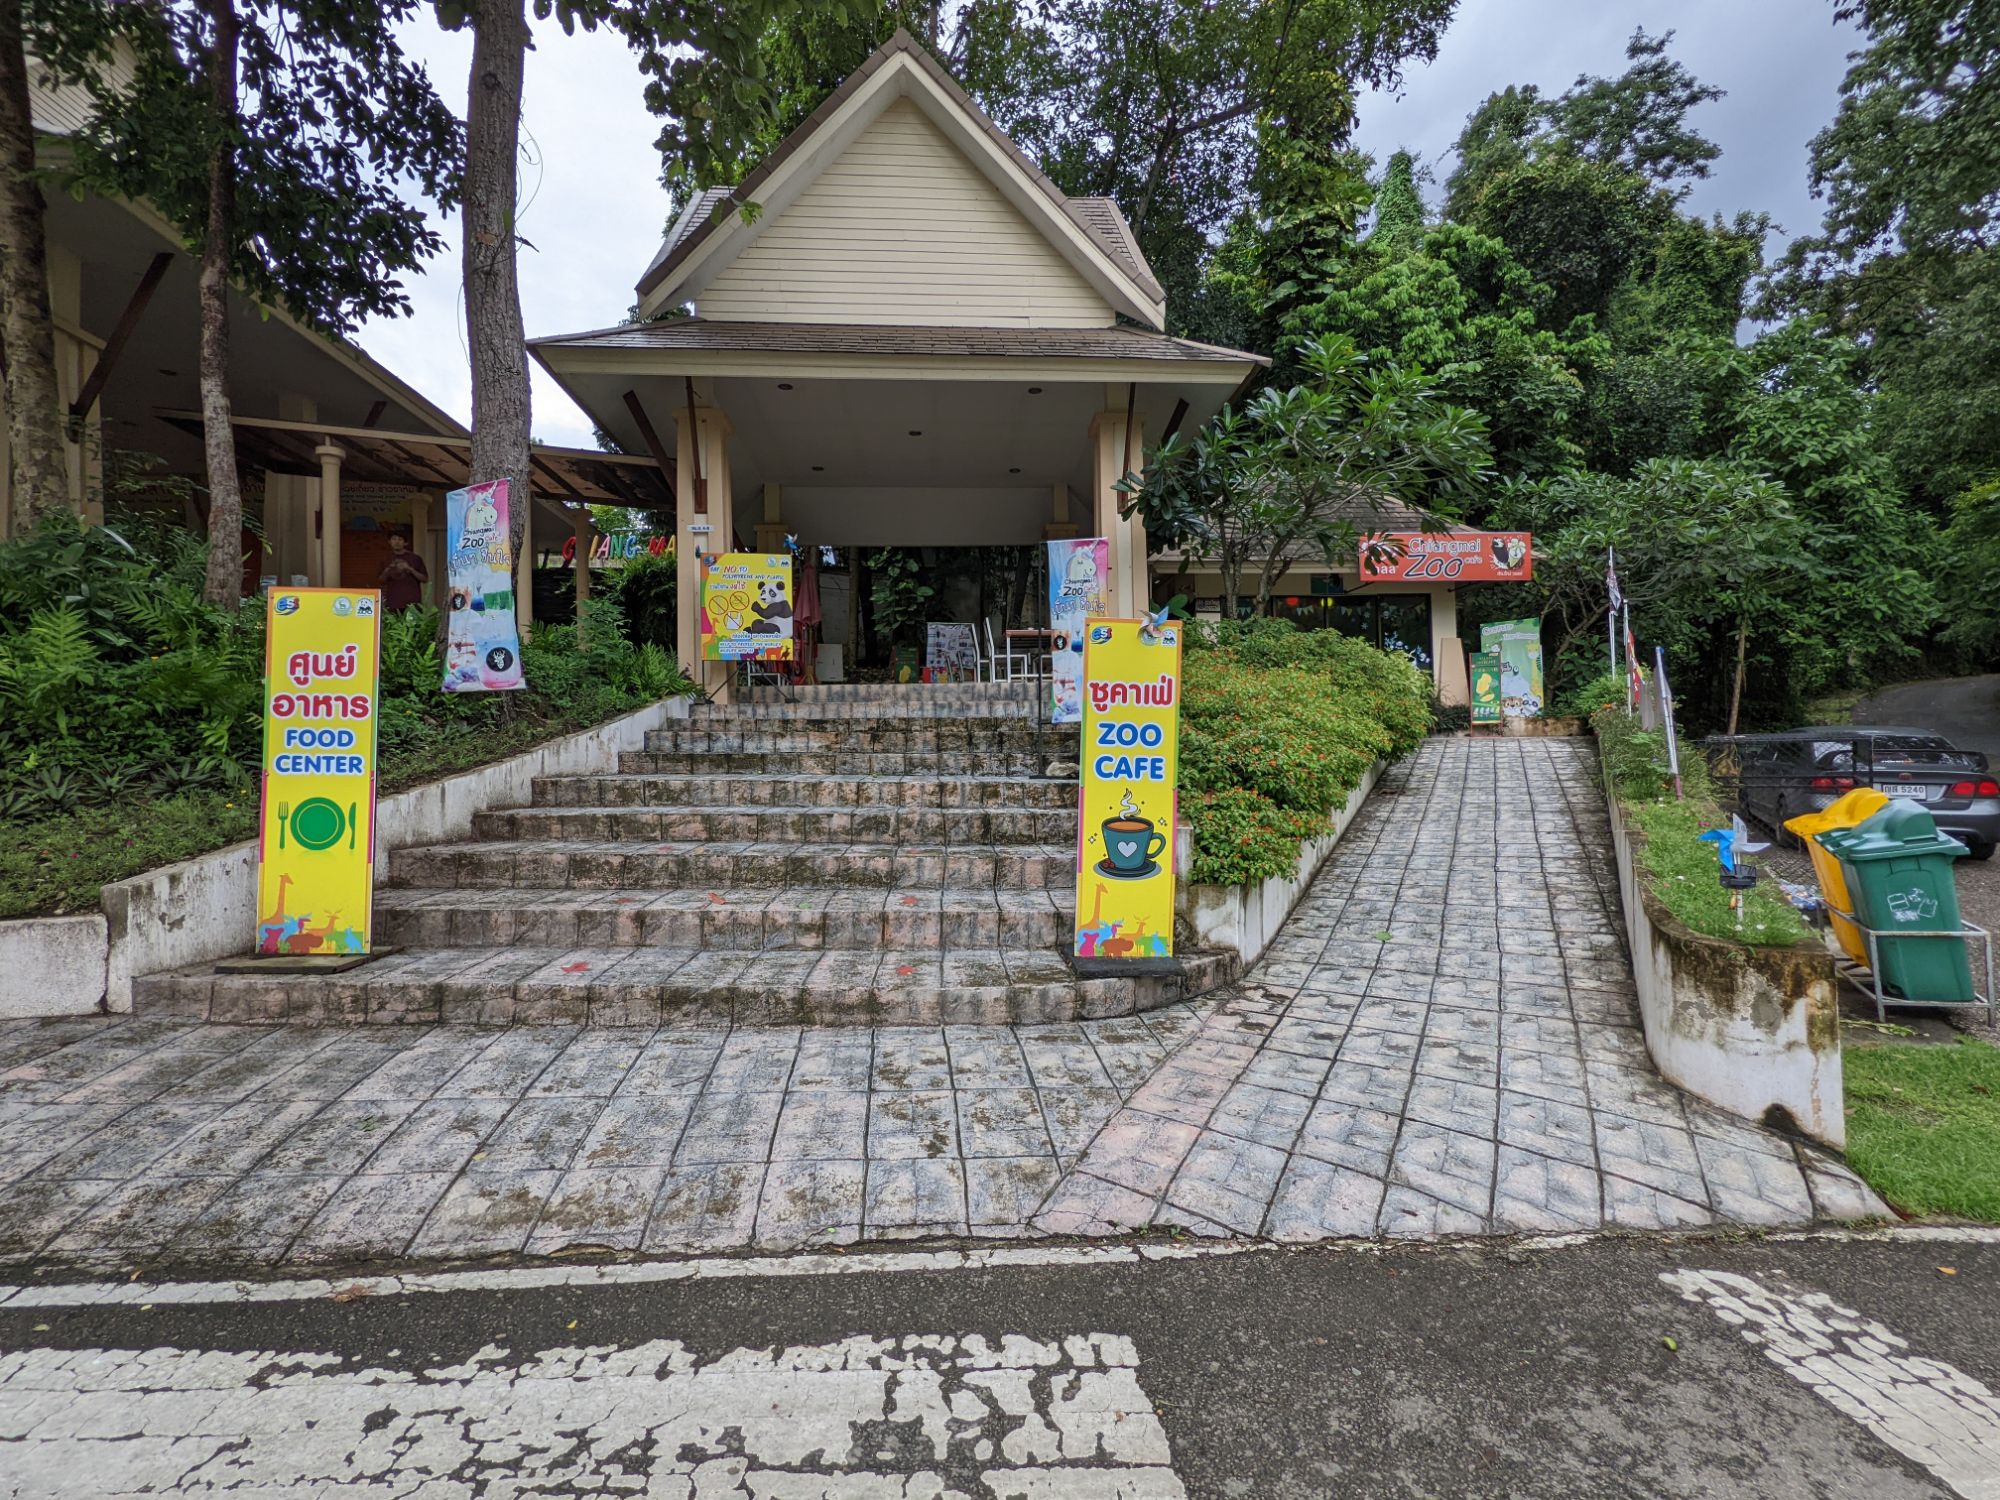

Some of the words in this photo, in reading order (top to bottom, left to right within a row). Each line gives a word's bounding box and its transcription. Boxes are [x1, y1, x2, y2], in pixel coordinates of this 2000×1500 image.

[562, 534, 640, 560] CIANG
[648, 534, 677, 560] MA
[1408, 537, 1481, 555] Chiangmai
[289, 645, 357, 686] ศูนย์
[1088, 675, 1173, 712] ซูคาเฟ่
[272, 694, 369, 719] อาหาร
[286, 729, 354, 747] FOOD
[1097, 722, 1162, 747] ZOO
[275, 755, 363, 774] CENTER
[1094, 755, 1164, 780] CAFE
[1901, 786, 1924, 794] 5240
